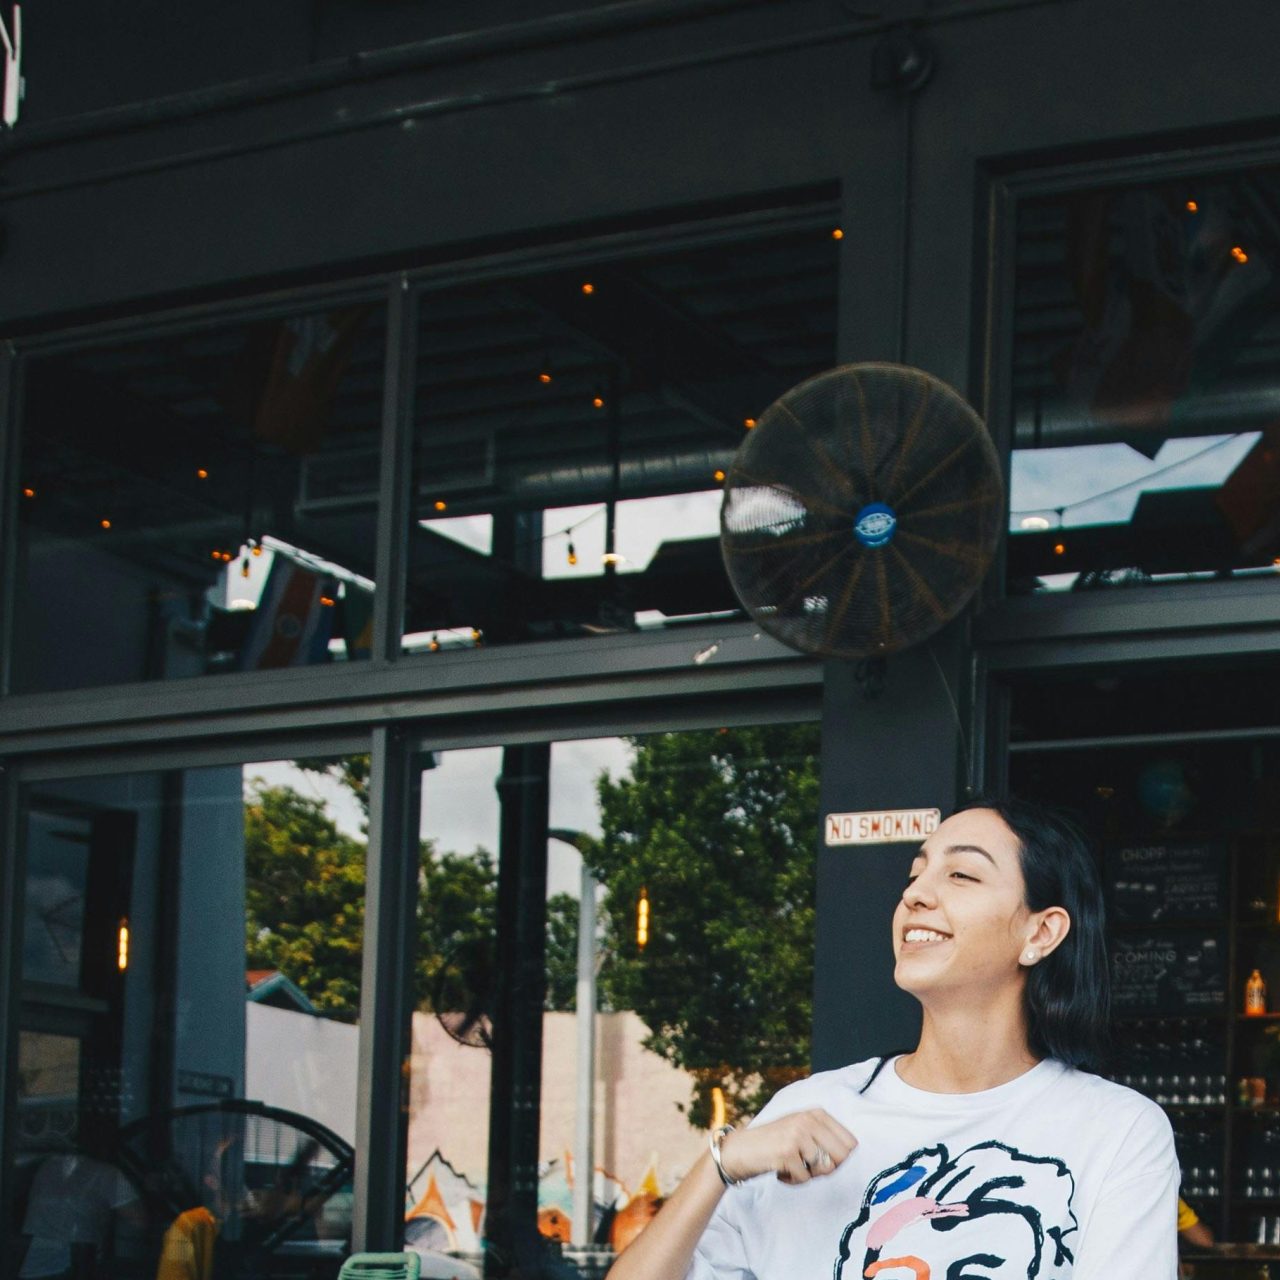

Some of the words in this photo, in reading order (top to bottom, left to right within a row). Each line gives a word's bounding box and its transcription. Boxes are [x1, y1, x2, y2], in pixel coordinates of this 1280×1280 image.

[830, 817, 853, 840] NO
[859, 814, 935, 838] SMOKING
[1113, 950, 1177, 965] COMING
